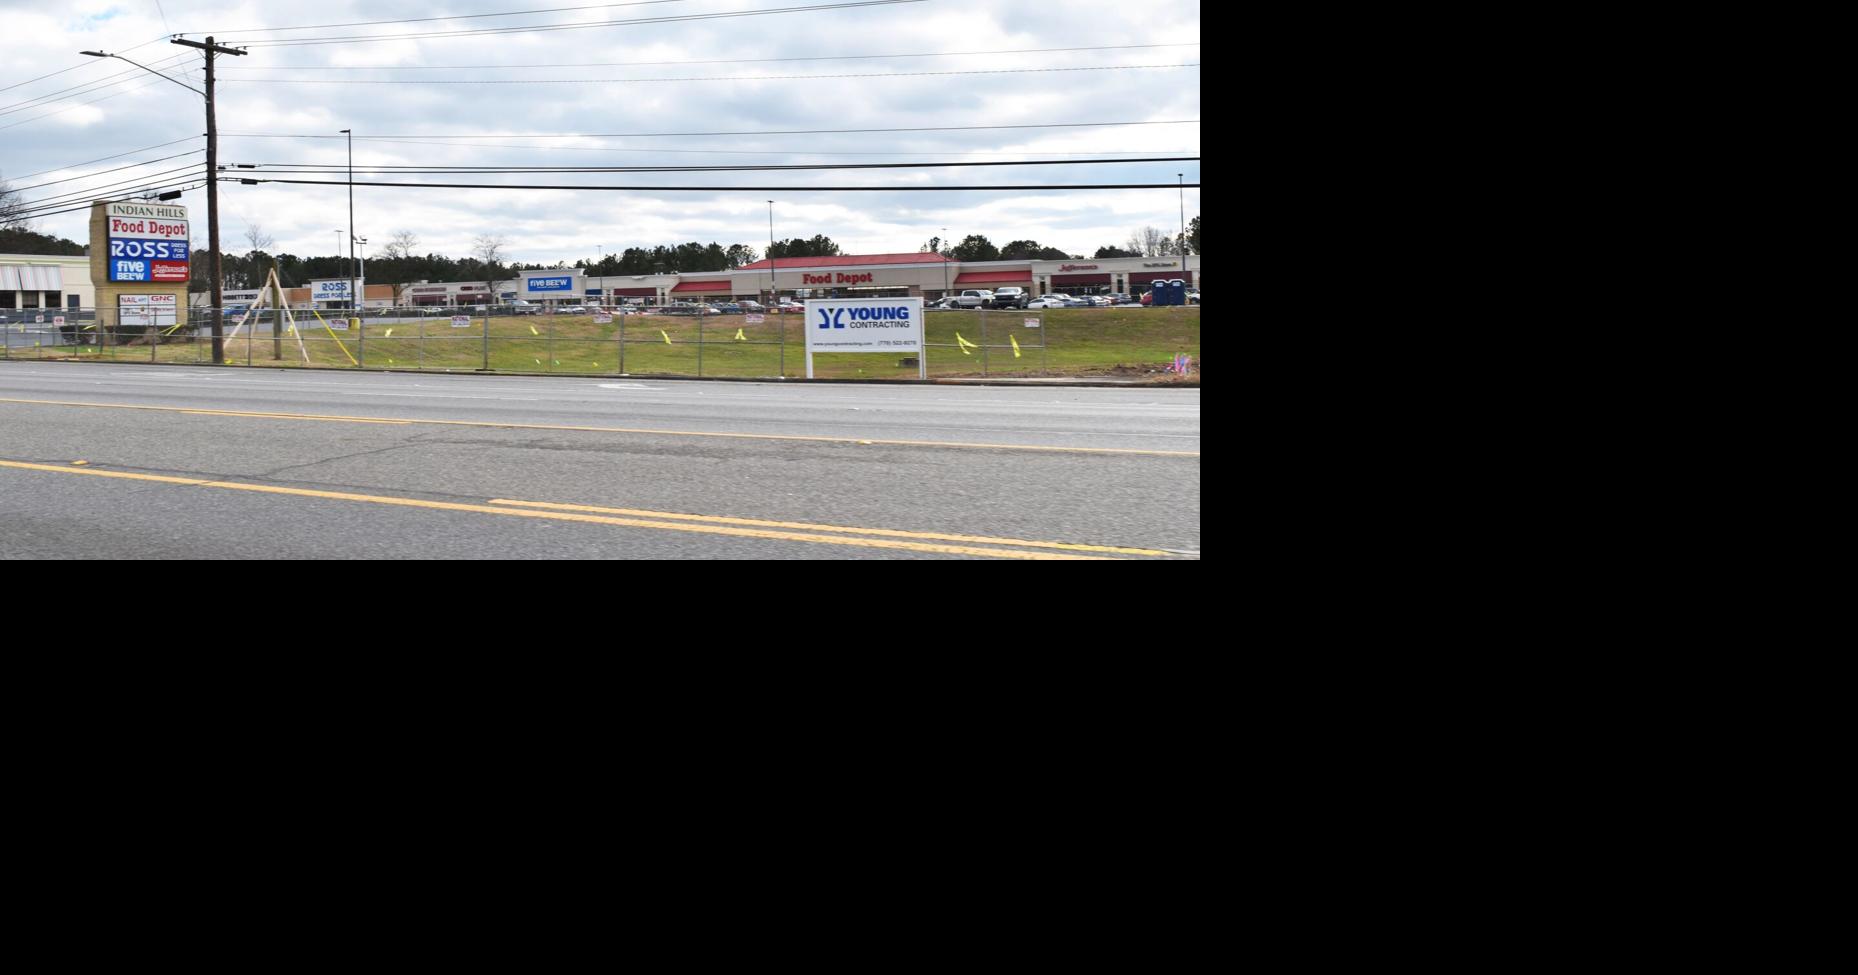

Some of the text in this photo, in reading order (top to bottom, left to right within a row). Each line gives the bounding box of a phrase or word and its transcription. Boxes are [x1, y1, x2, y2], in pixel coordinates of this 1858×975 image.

[113, 205, 185, 217] INDIAN HILLS
[112, 219, 186, 237] Food Depot
[111, 241, 169, 258] ROSS
[117, 261, 144, 272] five
[802, 272, 873, 285] Food Depot
[321, 282, 347, 291] ROSS
[847, 306, 909, 320] YOUNG
[850, 320, 910, 329] CONTRACTING
